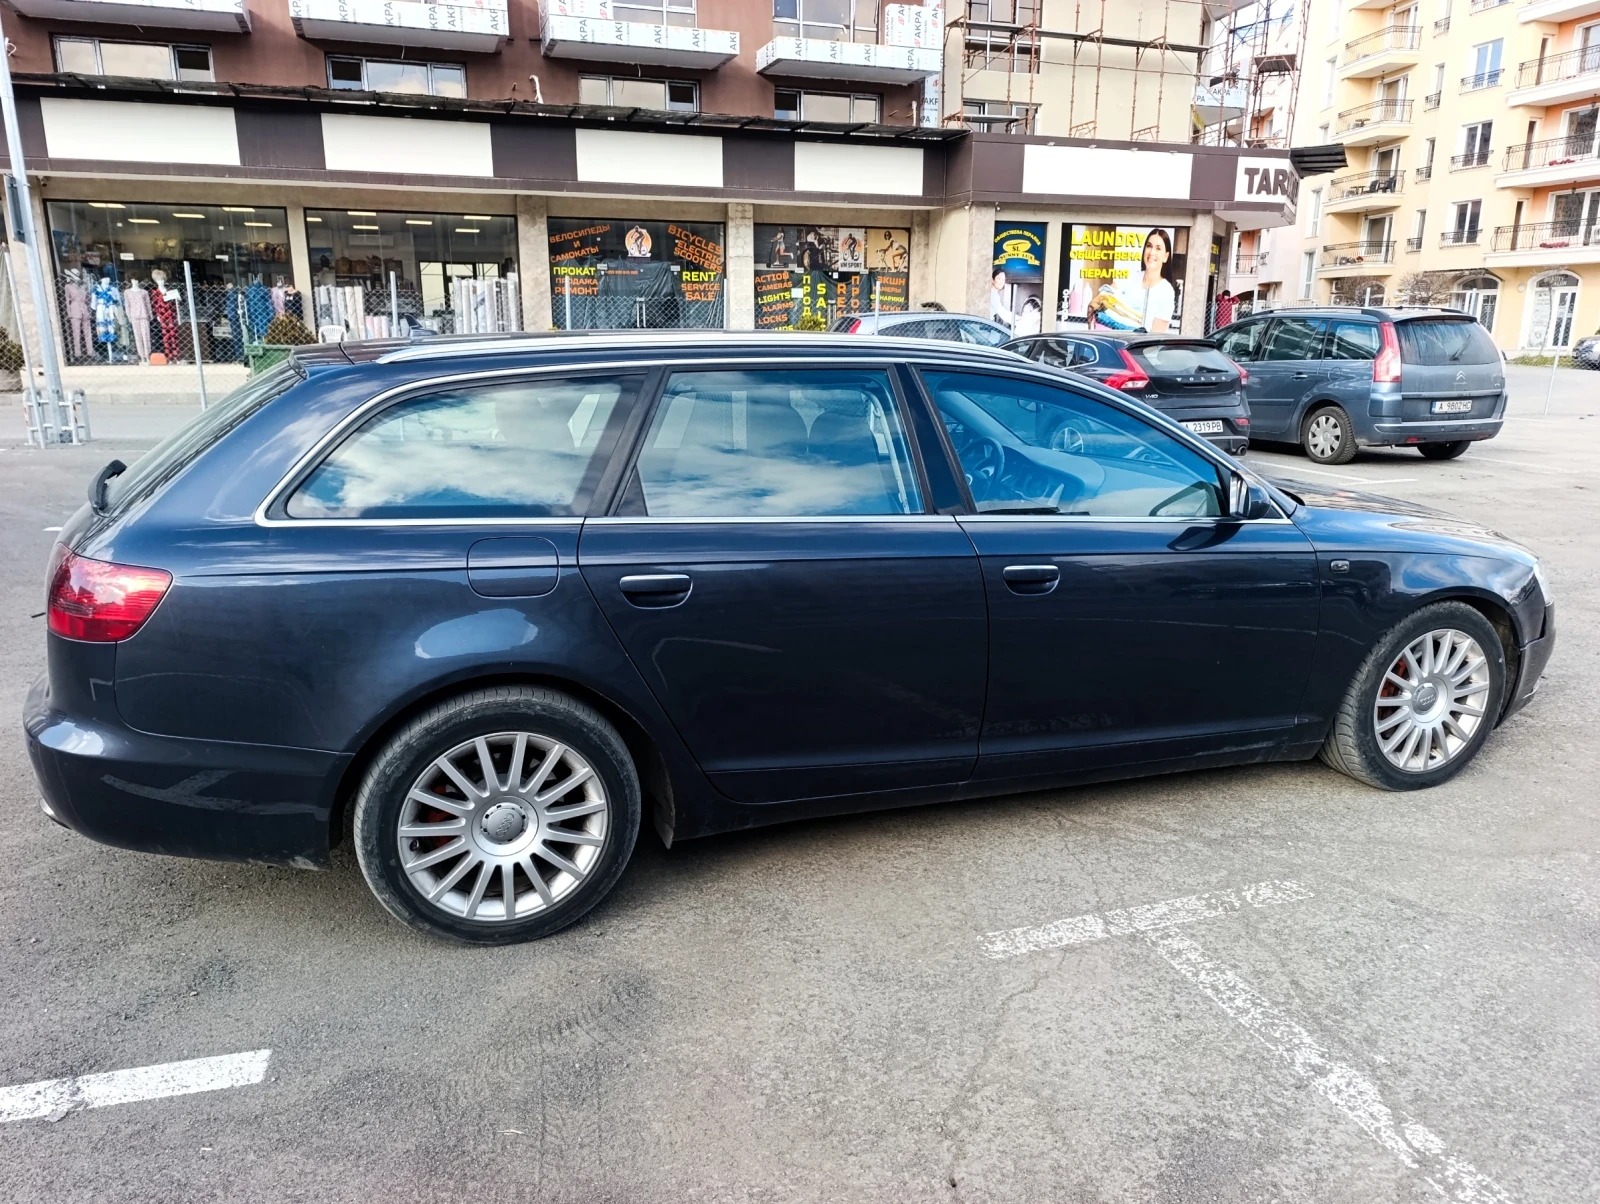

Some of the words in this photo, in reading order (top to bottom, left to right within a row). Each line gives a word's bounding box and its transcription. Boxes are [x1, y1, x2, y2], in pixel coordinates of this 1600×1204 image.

[549, 224, 611, 243] ВЕЛОСИПЕДЫ
[1071, 230, 1145, 248] LAUNDRY
[573, 240, 581, 248] И
[667, 224, 723, 256] BICYCLES
[550, 246, 599, 263] САМОКАТЫ
[677, 240, 724, 265] ELECTRIC
[1069, 250, 1142, 262] ОБЩЕСТВЕНА
[674, 246, 723, 274] SCOOTERS
[553, 267, 596, 276] ПРОКАТ
[682, 271, 717, 281] RENT
[1080, 268, 1129, 280] ПЕРАЛНЯ
[681, 283, 720, 291] SERVICE
[757, 281, 793, 292] CAMERAS
[685, 291, 716, 301] SALE
[758, 291, 791, 304] LIGHTS
[762, 301, 795, 313] ALARMS
[758, 313, 788, 325] LOCKS
